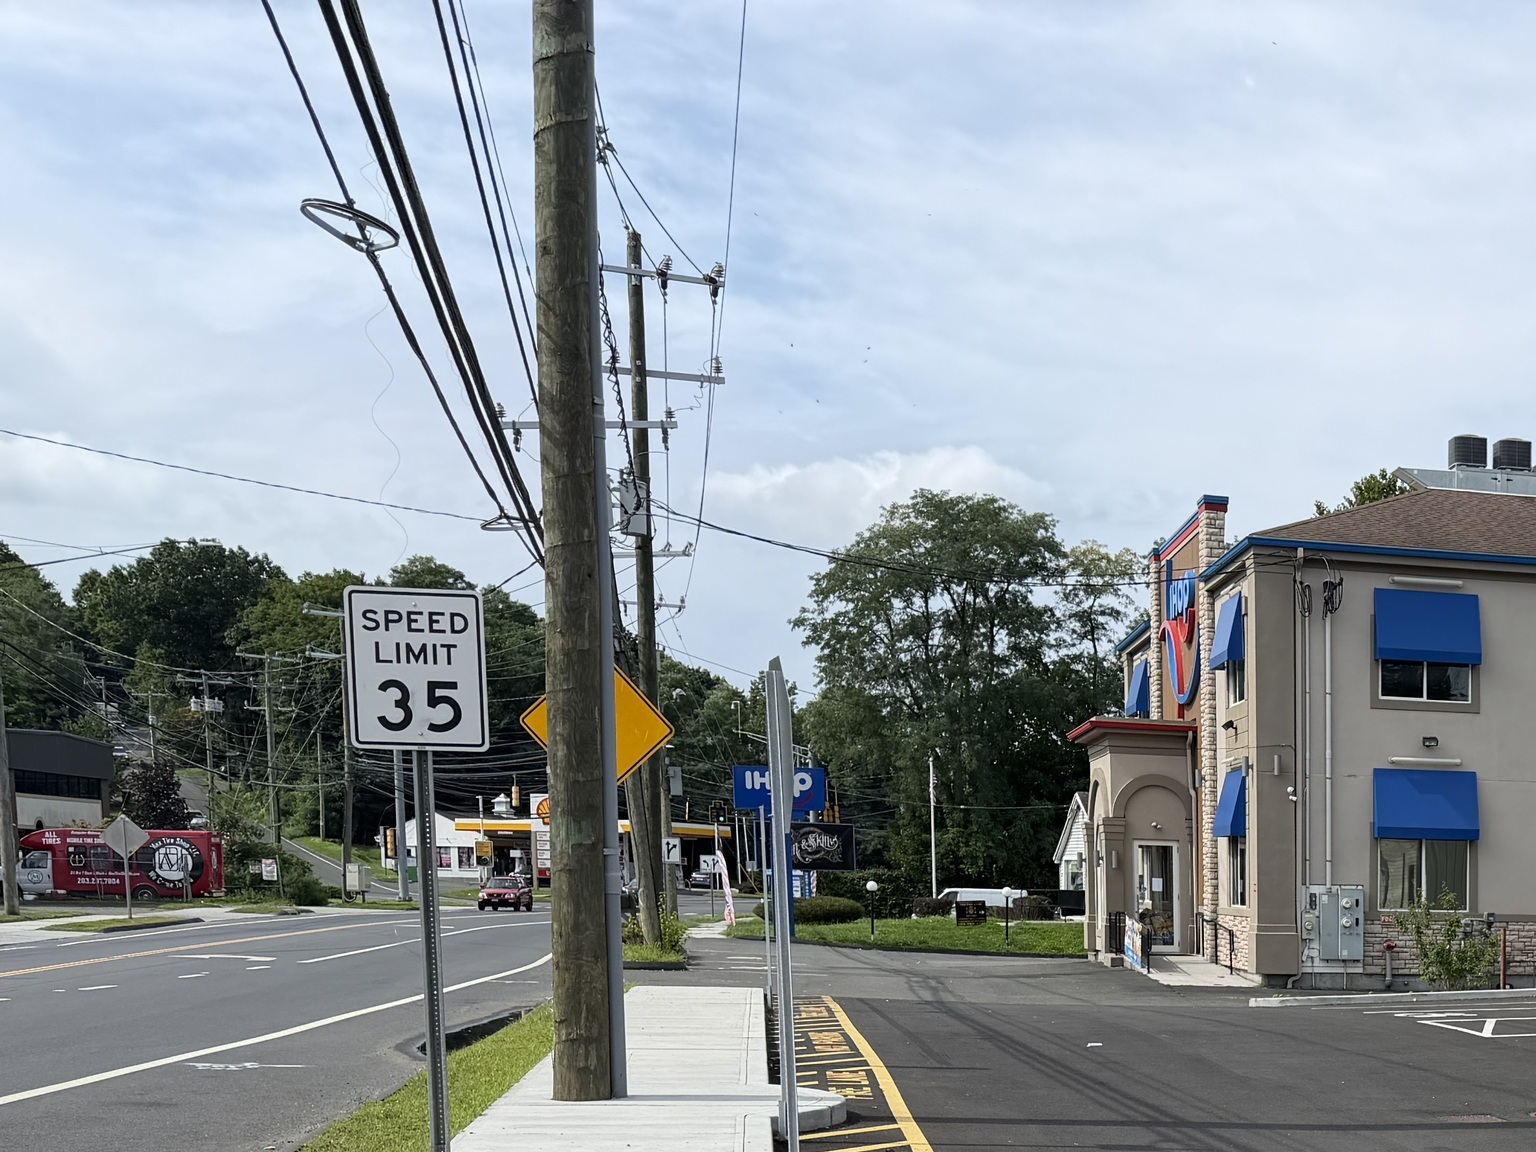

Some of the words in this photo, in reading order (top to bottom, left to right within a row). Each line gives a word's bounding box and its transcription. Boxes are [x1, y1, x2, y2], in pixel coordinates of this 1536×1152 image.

[361, 609, 469, 635] SPEED
[374, 641, 458, 666] LIMIT
[376, 679, 462, 733] 35
[744, 770, 813, 798] IHP
[42, 837, 62, 845] TIRES
